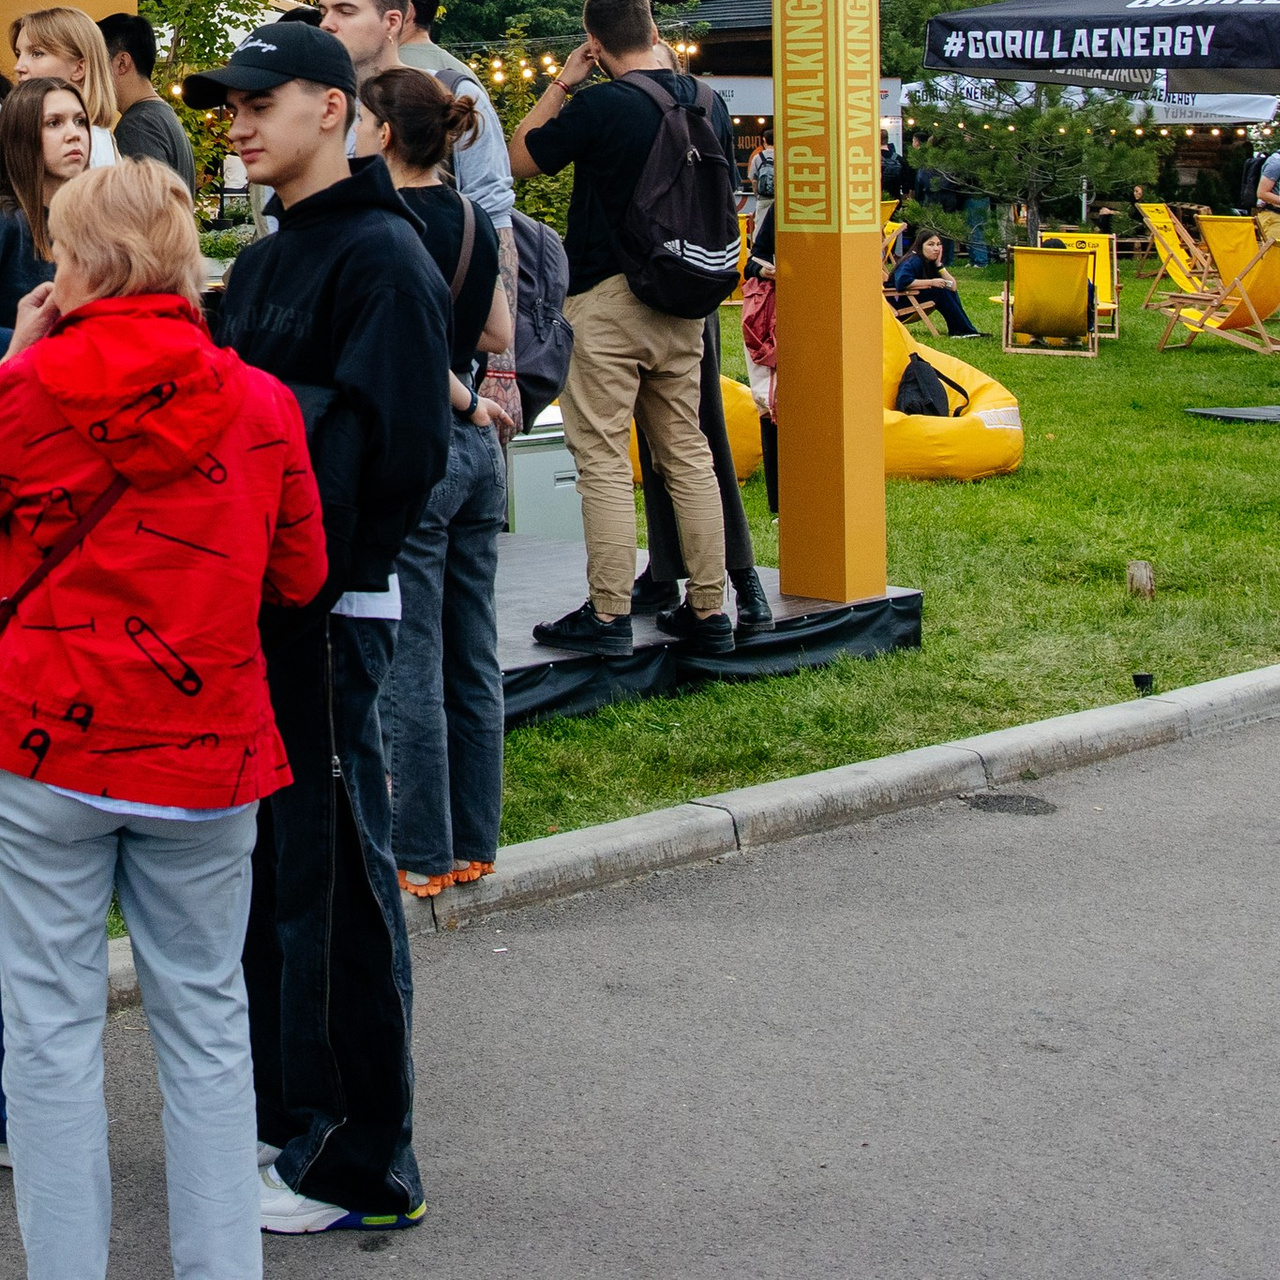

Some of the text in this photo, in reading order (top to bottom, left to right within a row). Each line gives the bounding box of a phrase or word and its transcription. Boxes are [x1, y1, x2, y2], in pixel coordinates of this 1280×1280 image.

[943, 25, 1216, 60] #GORILLAENERGY
[787, 145, 827, 221] KEEP
[848, 145, 874, 221] KEEP
